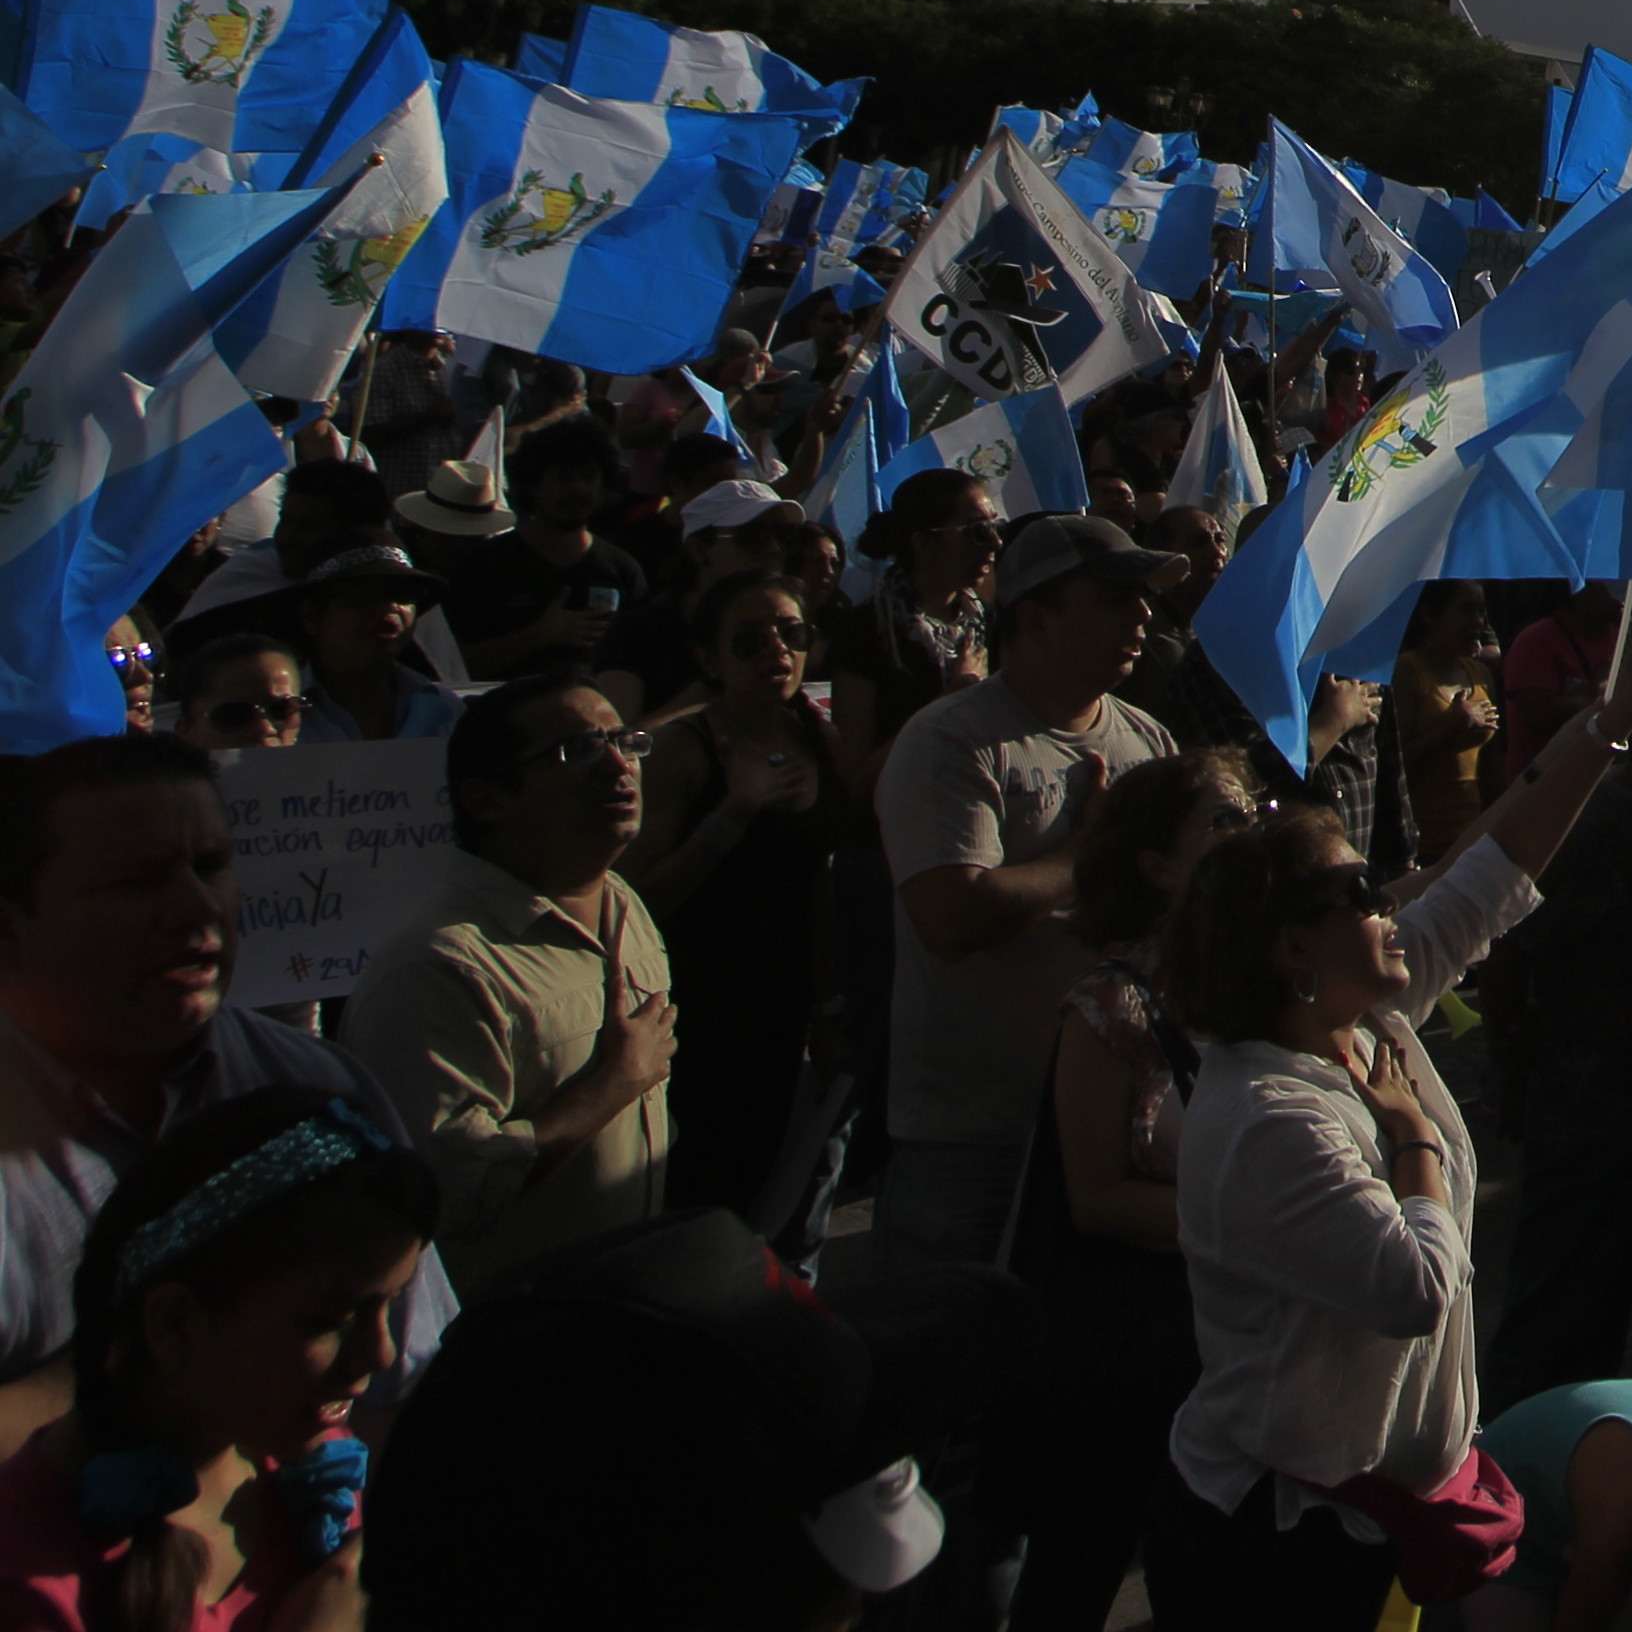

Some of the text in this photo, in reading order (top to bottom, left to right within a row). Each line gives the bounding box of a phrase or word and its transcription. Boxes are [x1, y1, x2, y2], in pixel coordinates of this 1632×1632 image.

[1033, 201, 1089, 270] Campesino
[1087, 268, 1111, 290] del
[281, 780, 411, 817] metieron
[233, 827, 322, 856] ación
